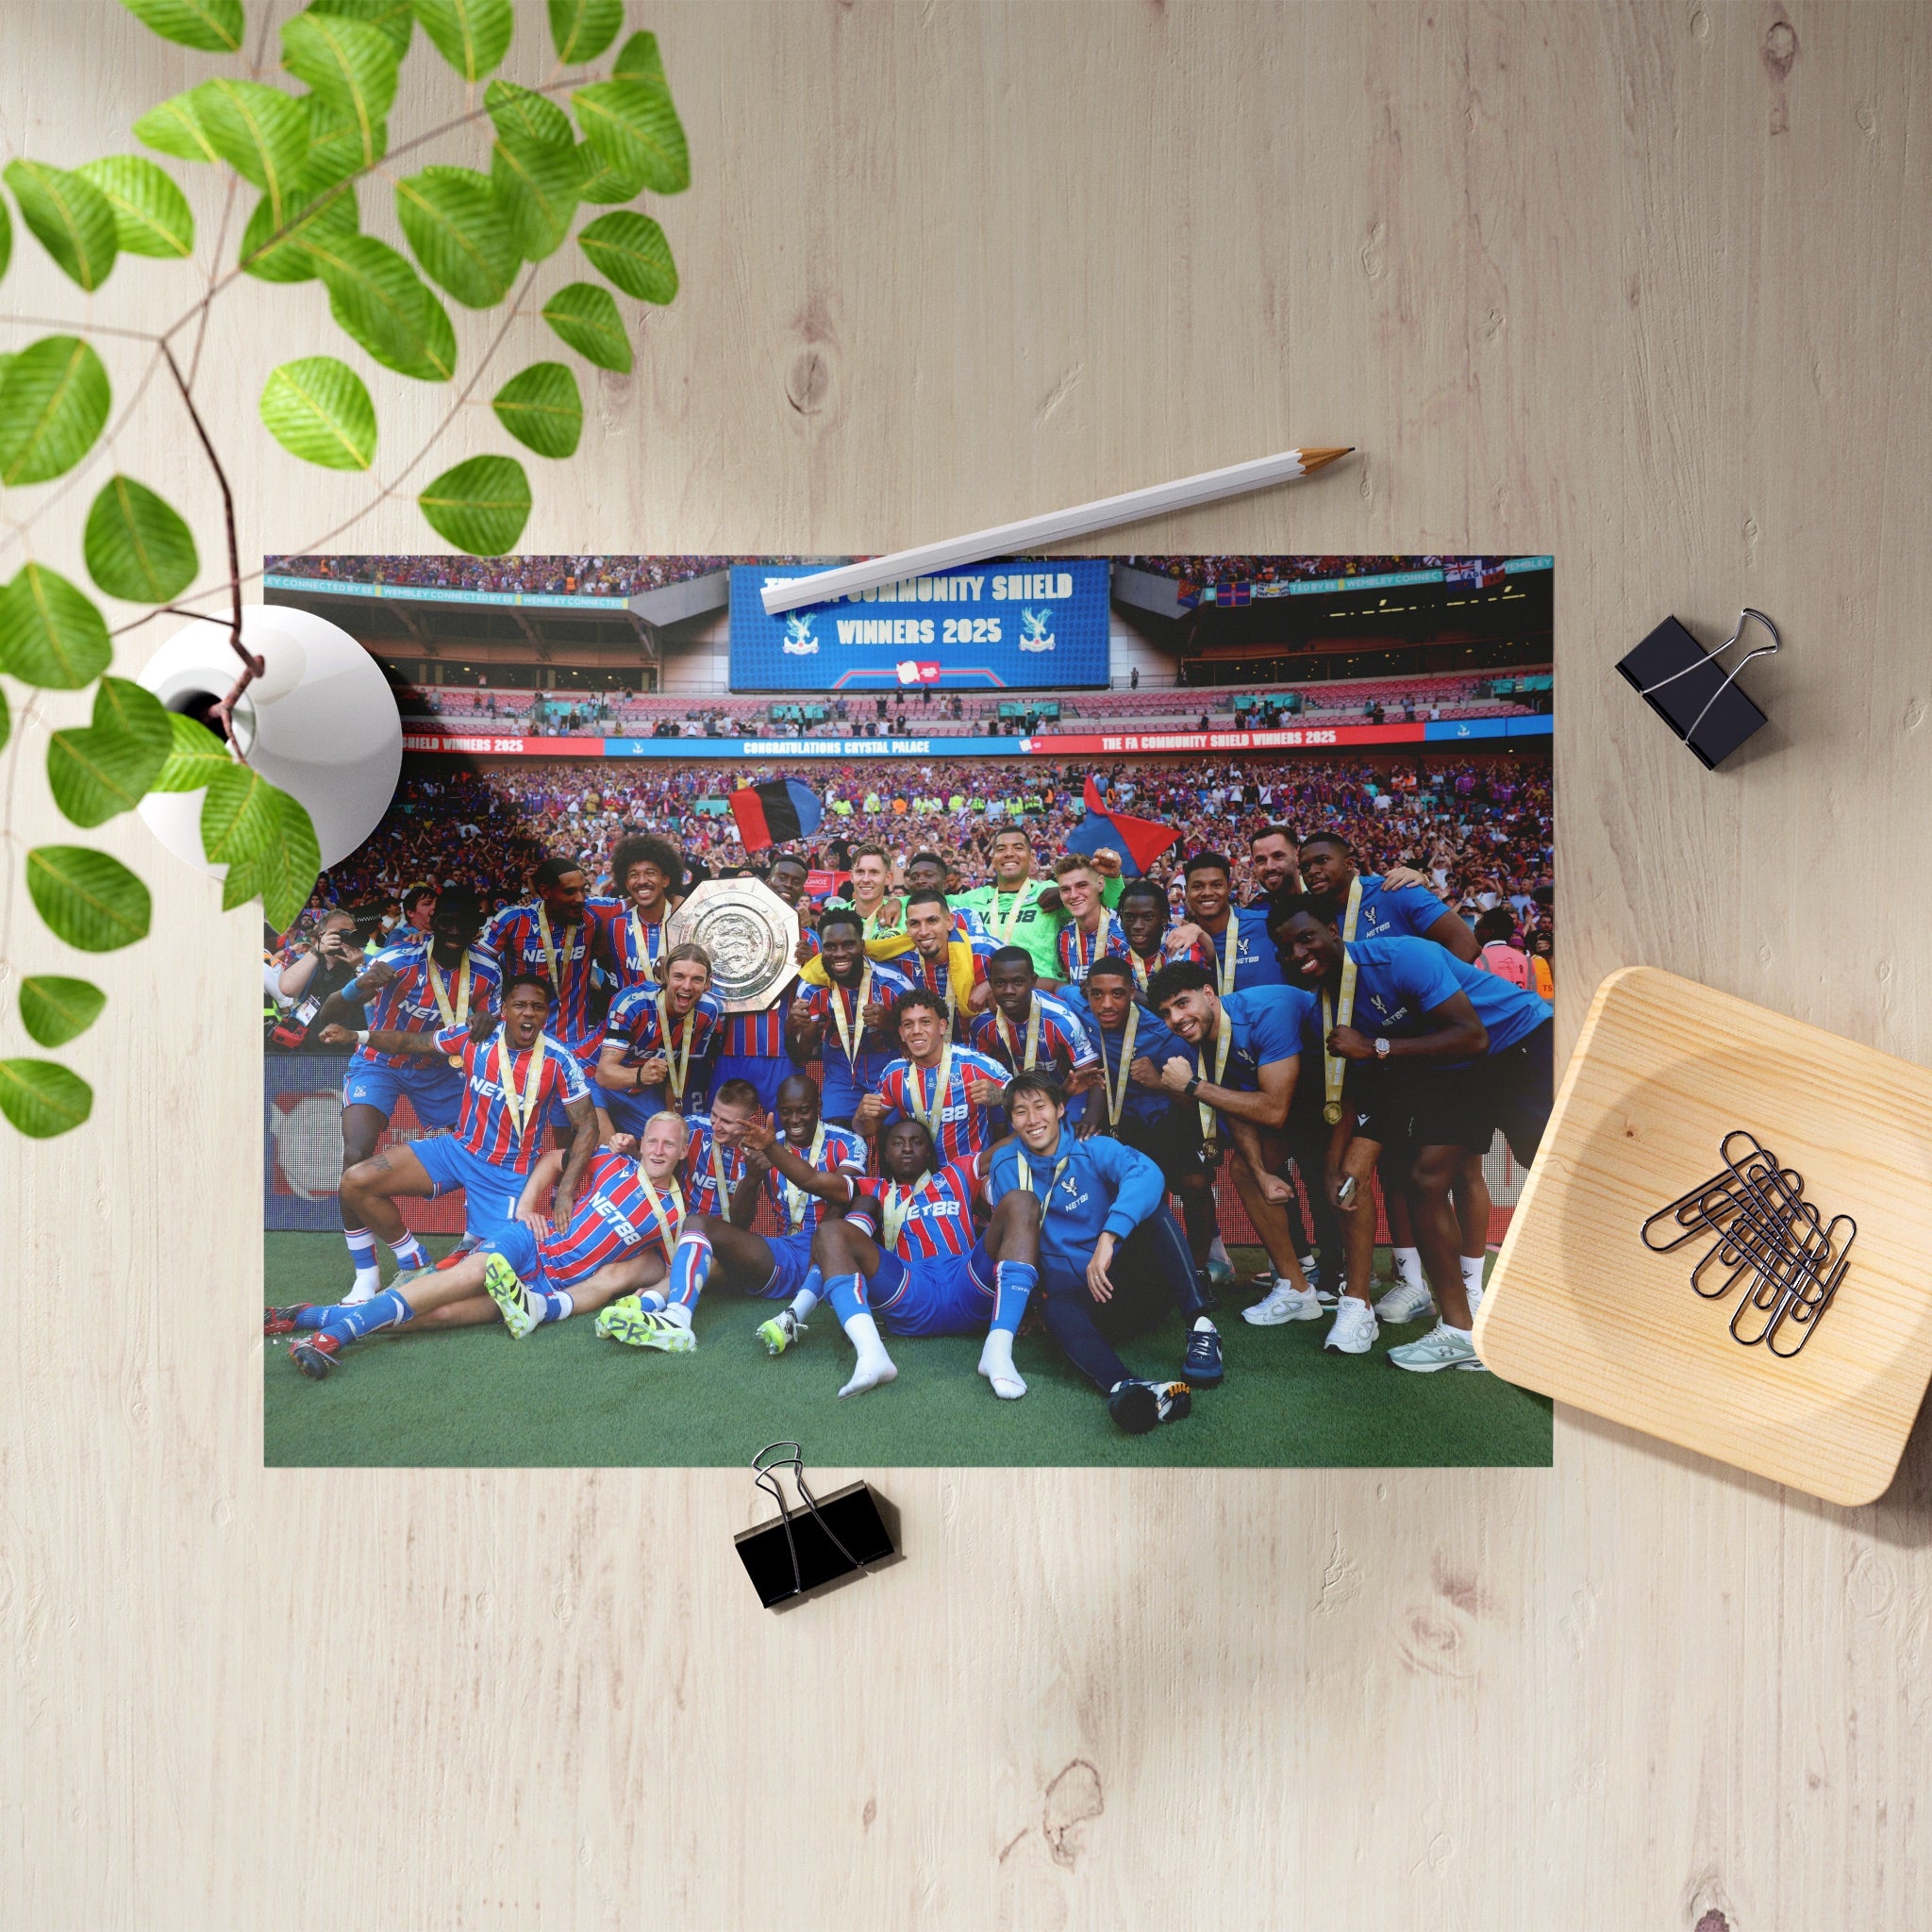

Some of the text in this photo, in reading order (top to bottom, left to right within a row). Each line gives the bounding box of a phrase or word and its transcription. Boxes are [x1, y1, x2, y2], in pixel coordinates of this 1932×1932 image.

[264, 576, 281, 585] EY
[283, 578, 345, 591] CONNECTED
[347, 586, 360, 594] BY
[992, 573, 1073, 600] SHIELD
[1311, 582, 1324, 591] BY
[1325, 581, 1336, 590] EE
[1347, 577, 1392, 588] WEMBLEY
[384, 588, 430, 598] WEMBLEY
[431, 591, 487, 602] CONNECTED
[490, 594, 502, 602] BY
[523, 597, 622, 607] WEMBLEY CONNECTED
[836, 618, 1002, 645] WINNERS 2025
[442, 738, 491, 751] WINNERS
[494, 739, 524, 752] 2025
[743, 741, 930, 754] CONGRATULATIONS CRYSTAL PALACE
[1102, 730, 1336, 750] THE FA COMMUNITY SHIELD WINNERS 2025
[589, 1191, 642, 1246] NET88
[906, 1200, 960, 1221] ET88
